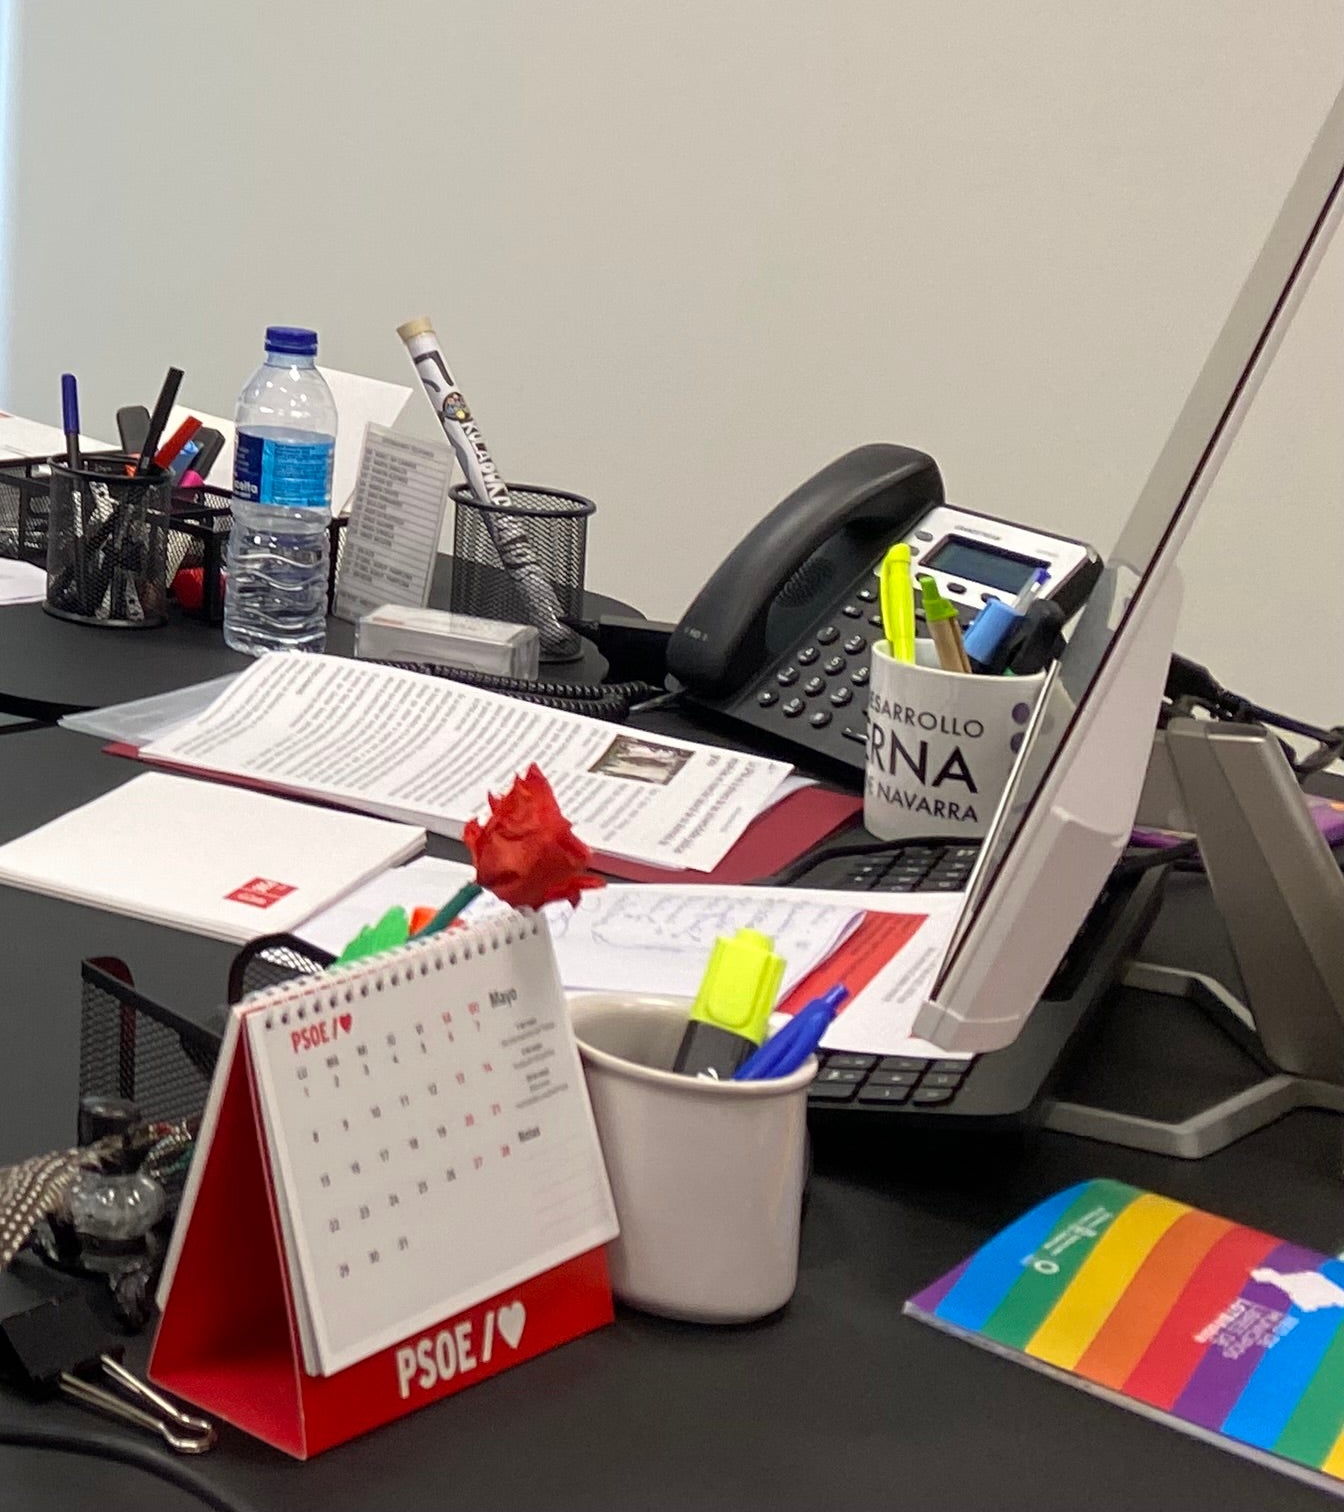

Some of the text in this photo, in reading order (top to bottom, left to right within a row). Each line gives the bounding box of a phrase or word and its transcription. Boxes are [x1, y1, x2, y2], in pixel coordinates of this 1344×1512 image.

[866, 722, 979, 794] RNA
[876, 781, 979, 824] NAVARRA
[487, 987, 518, 1009] Mayo
[290, 1020, 330, 1055] PSOE
[396, 1320, 478, 1400] PSOE
